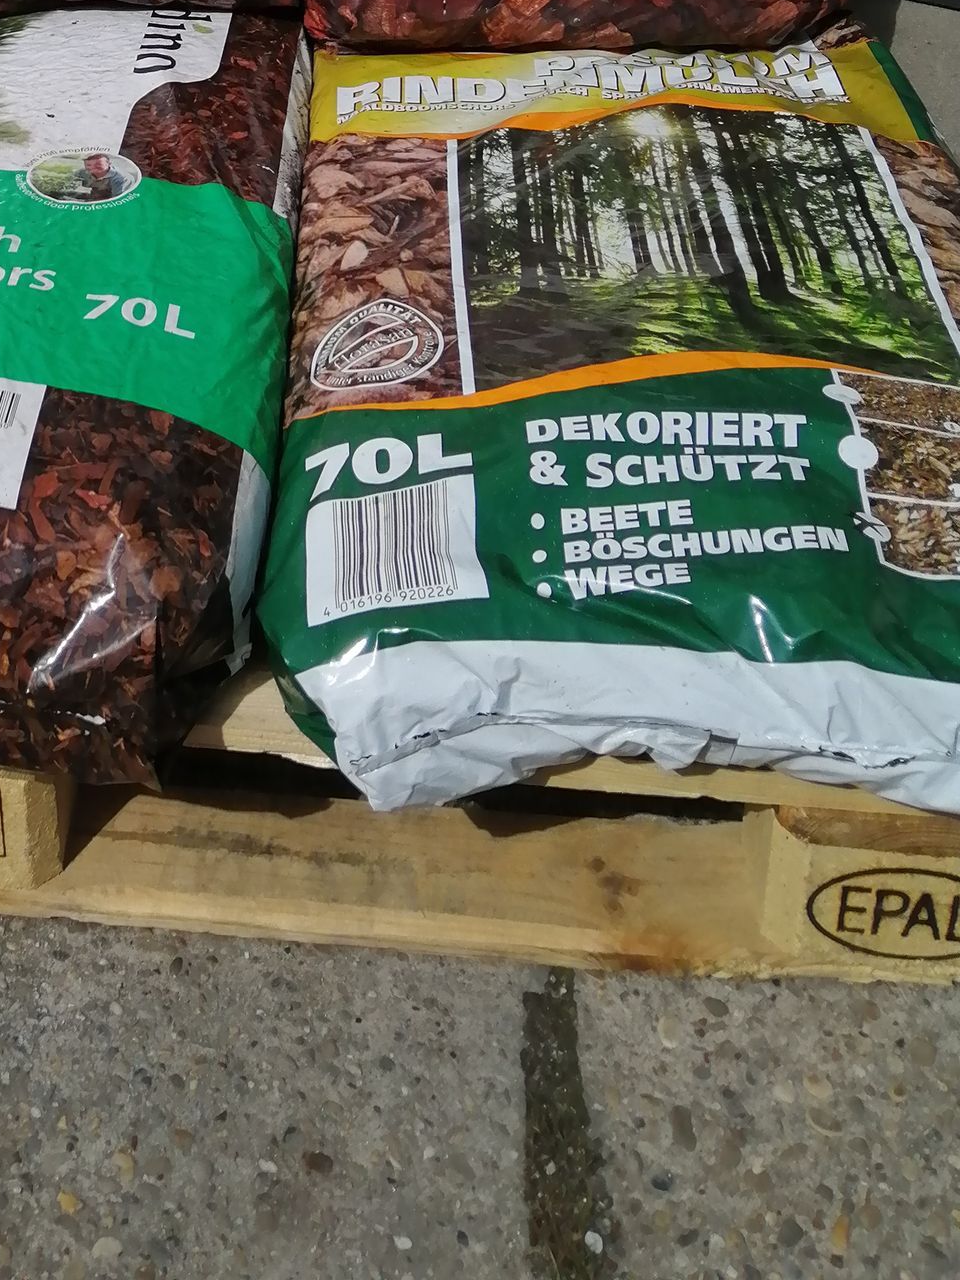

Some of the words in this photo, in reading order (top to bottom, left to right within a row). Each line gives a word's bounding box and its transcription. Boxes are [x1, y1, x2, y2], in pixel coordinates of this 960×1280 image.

[133, 10, 214, 74] dino
[337, 64, 847, 116] RINDENMULH
[83, 293, 197, 339] 70L
[350, 303, 422, 325] QUALITÄT
[525, 411, 808, 448] DEKORIERT
[305, 433, 473, 502] 70L
[529, 450, 569, 487] &
[586, 447, 811, 488] SCHÜTZT
[560, 499, 694, 535] BEETE
[563, 525, 850, 564] BÖSCHUNGEN
[323, 606, 331, 617] 4
[340, 592, 392, 613] 016196
[399, 586, 454, 602] 920226
[564, 562, 691, 601] WEGE
[836, 886, 960, 942] EPAL
